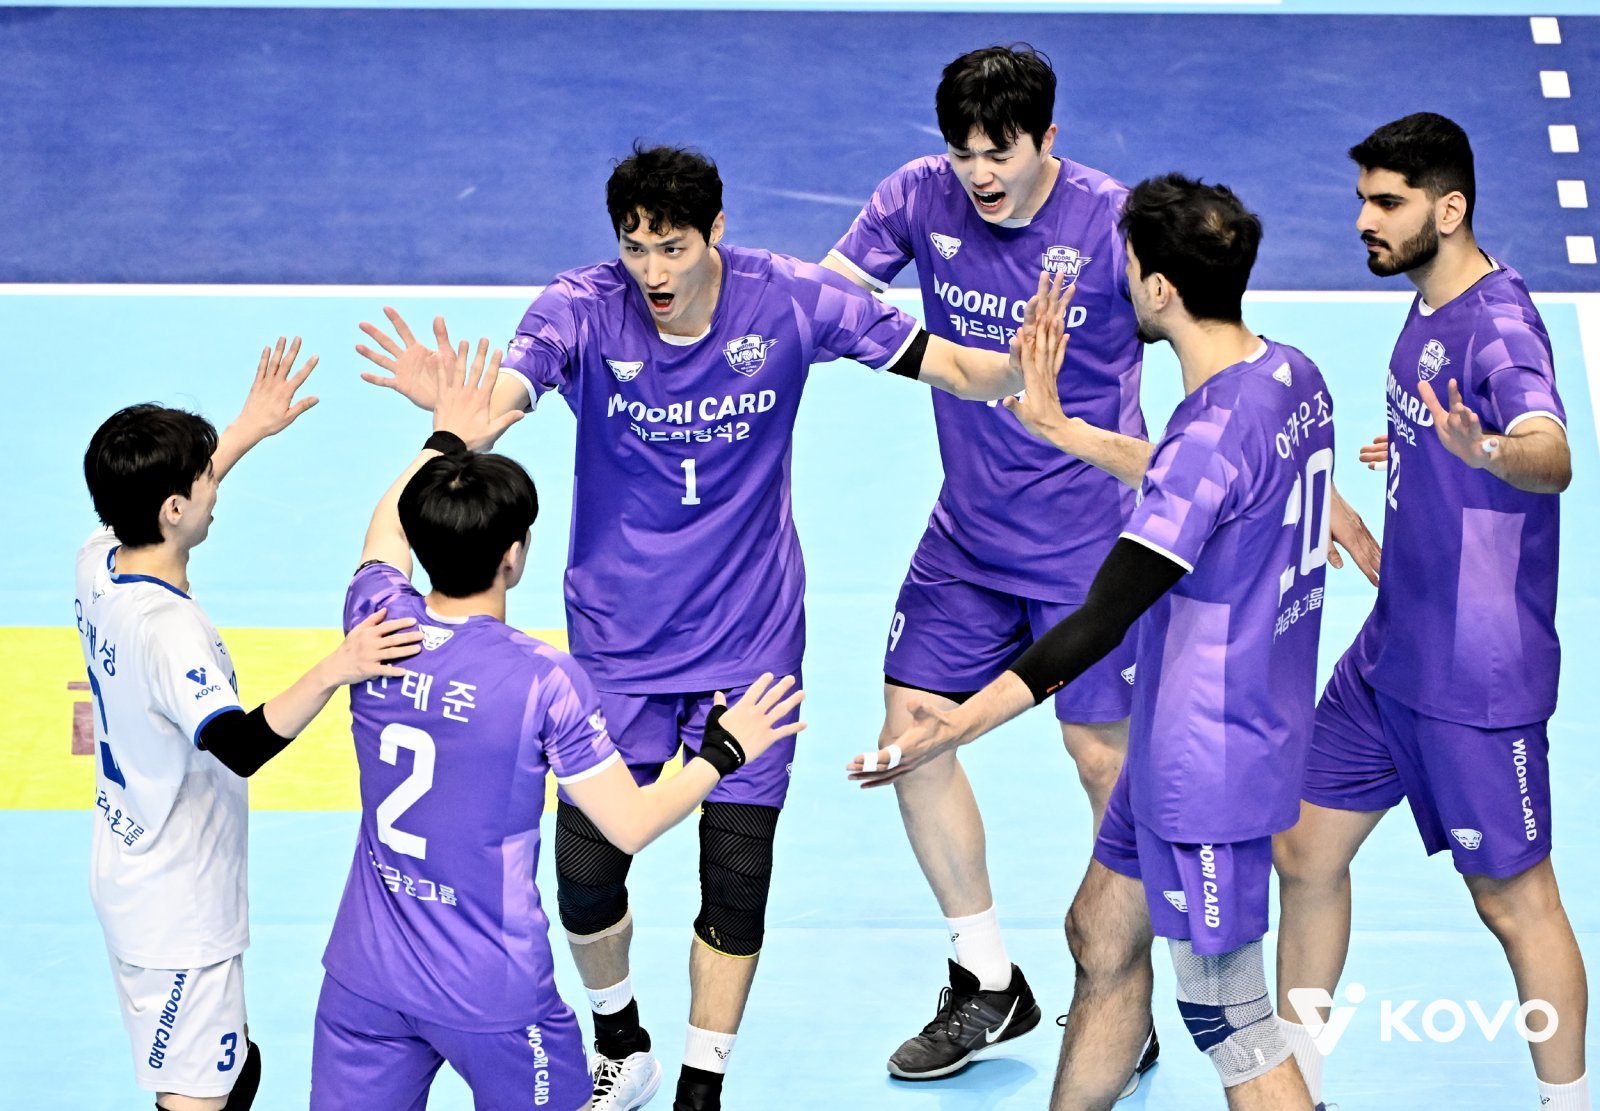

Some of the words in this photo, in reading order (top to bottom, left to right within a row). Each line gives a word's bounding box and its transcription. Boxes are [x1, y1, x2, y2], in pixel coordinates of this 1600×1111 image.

[607, 393, 693, 425] WOORI
[699, 389, 777, 421] CARD
[1395, 384, 1434, 427] CARD
[630, 421, 751, 443] 카드의정석2
[680, 458, 701, 506] 1
[195, 684, 221, 700] KOVO
[376, 722, 437, 861] 2
[1512, 738, 1528, 795] WOORI
[1521, 795, 1538, 841] CARD
[1203, 880, 1220, 928] CARD
[159, 972, 188, 1029] WOORI
[148, 1026, 170, 1070] CARD
[216, 1031, 238, 1072] 3
[526, 1024, 549, 1069] WOORI
[534, 1070, 549, 1106] CARD
